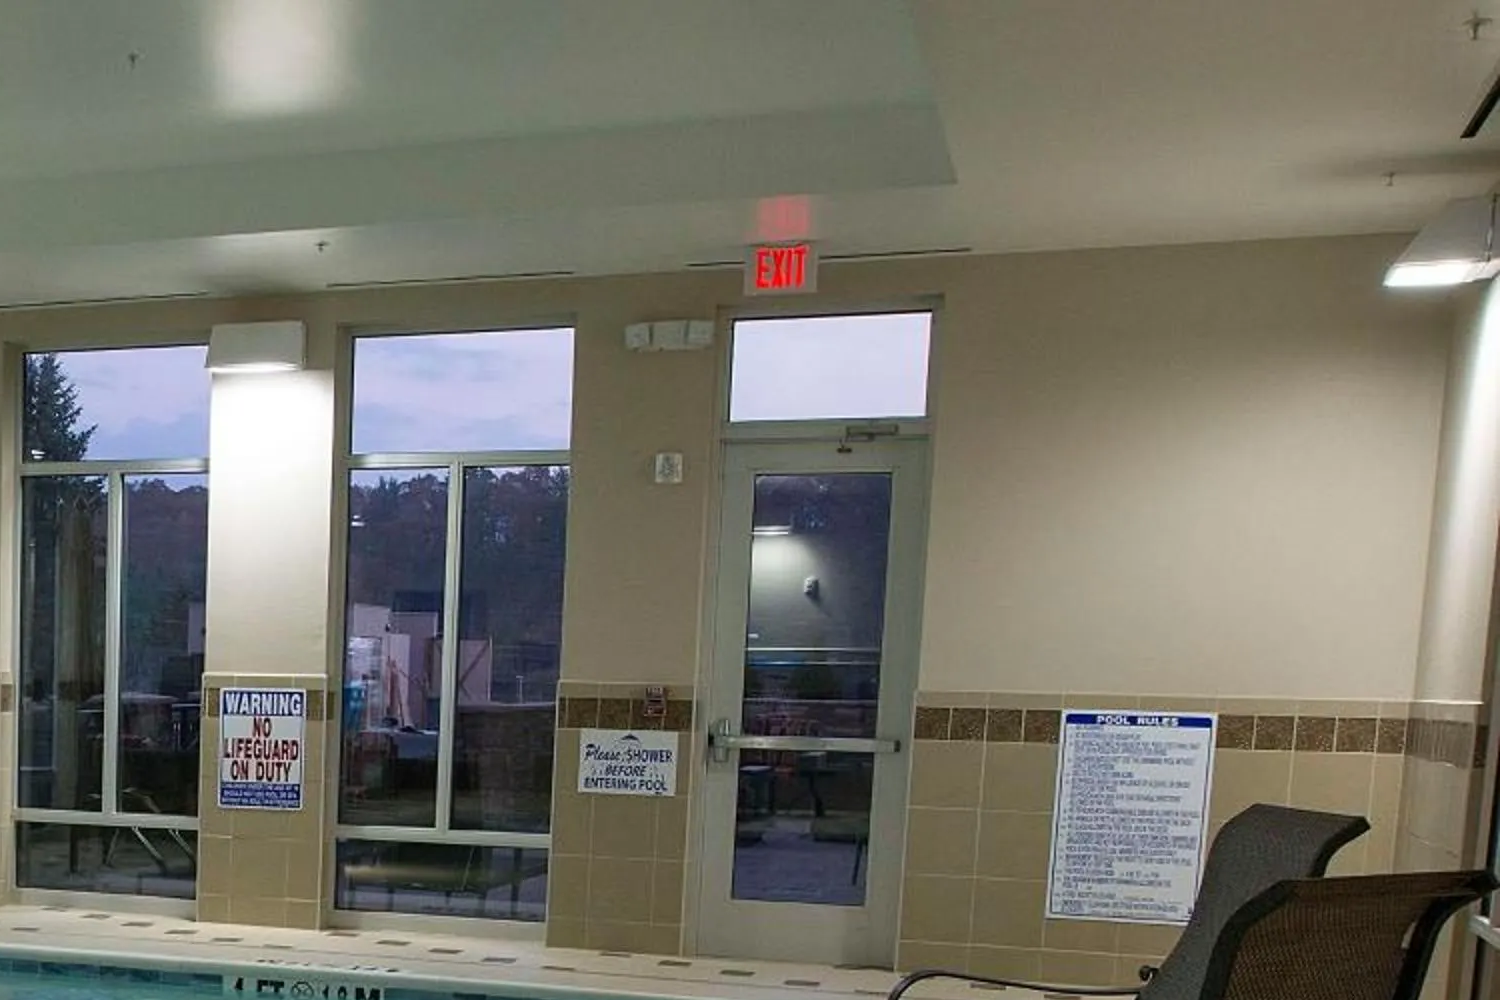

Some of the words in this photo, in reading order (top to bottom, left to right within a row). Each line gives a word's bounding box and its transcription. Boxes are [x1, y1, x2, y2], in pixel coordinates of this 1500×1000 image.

[756, 246, 809, 288] EXIT
[225, 692, 301, 715] WARNING
[252, 717, 272, 738] NO
[1096, 715, 1130, 726] POOL
[1137, 717, 1179, 728] RULES
[224, 738, 299, 760] LIFEGUARD
[627, 749, 673, 763] SHOWER
[231, 760, 249, 780] ON
[256, 762, 291, 782] DUTY
[605, 764, 647, 777] BEFORE
[584, 777, 636, 790] ENTERING
[639, 780, 668, 791] POOL
